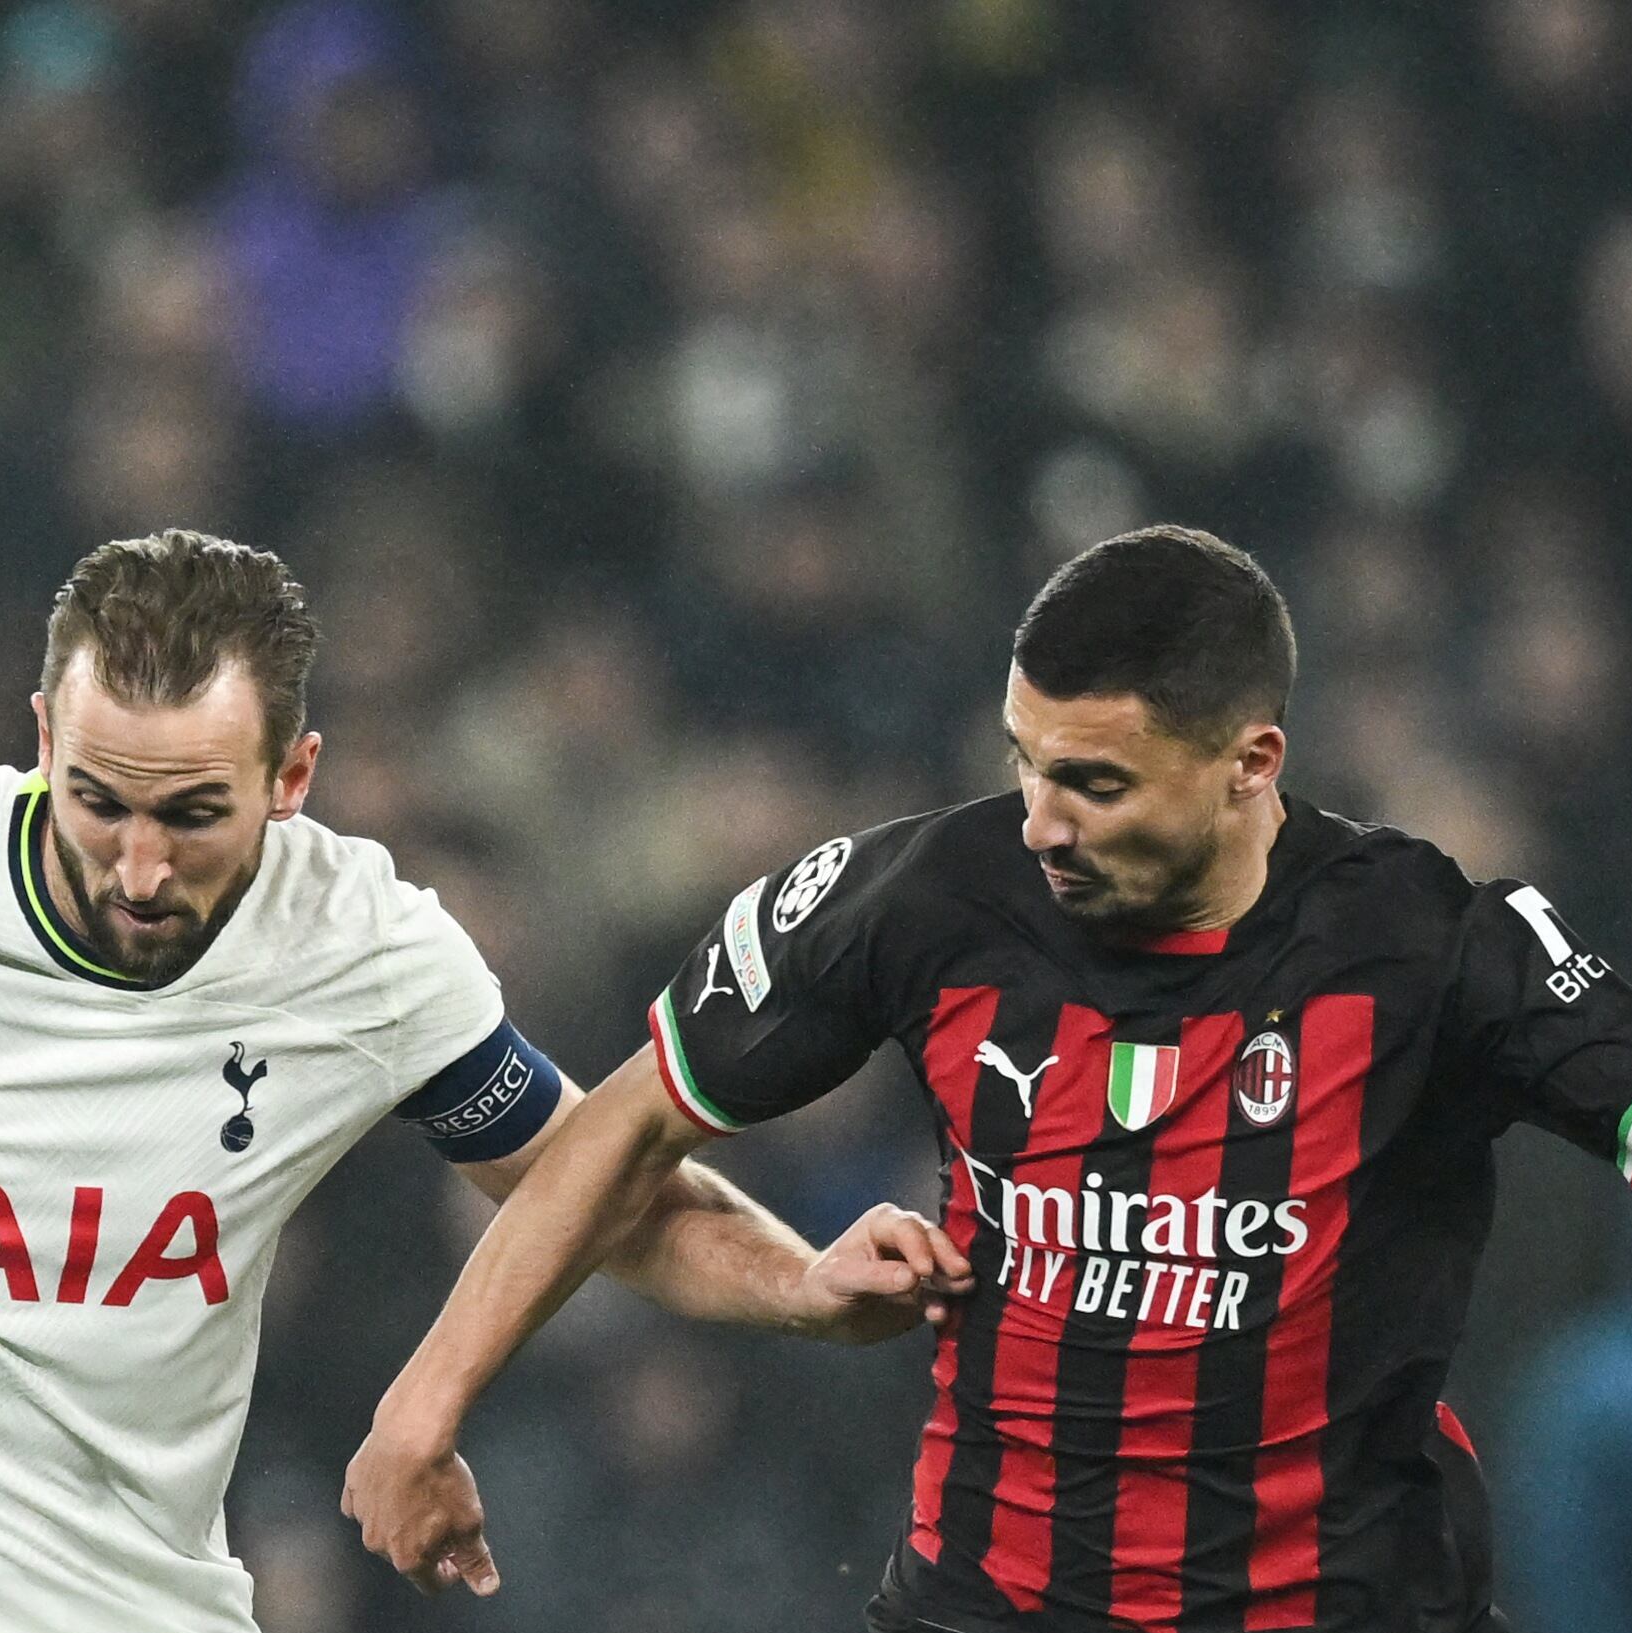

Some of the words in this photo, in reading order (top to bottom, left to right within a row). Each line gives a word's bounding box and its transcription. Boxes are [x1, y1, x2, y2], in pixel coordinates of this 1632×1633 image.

[1545, 953, 1614, 1003] Bit
[1249, 1033, 1284, 1054] ACM
[432, 1051, 529, 1135] RESPECT
[1248, 1103, 1278, 1117] 1899
[961, 1148, 1309, 1258] Emirates
[997, 1237, 1067, 1304] FLY
[1074, 1256, 1250, 1331] BETTER
